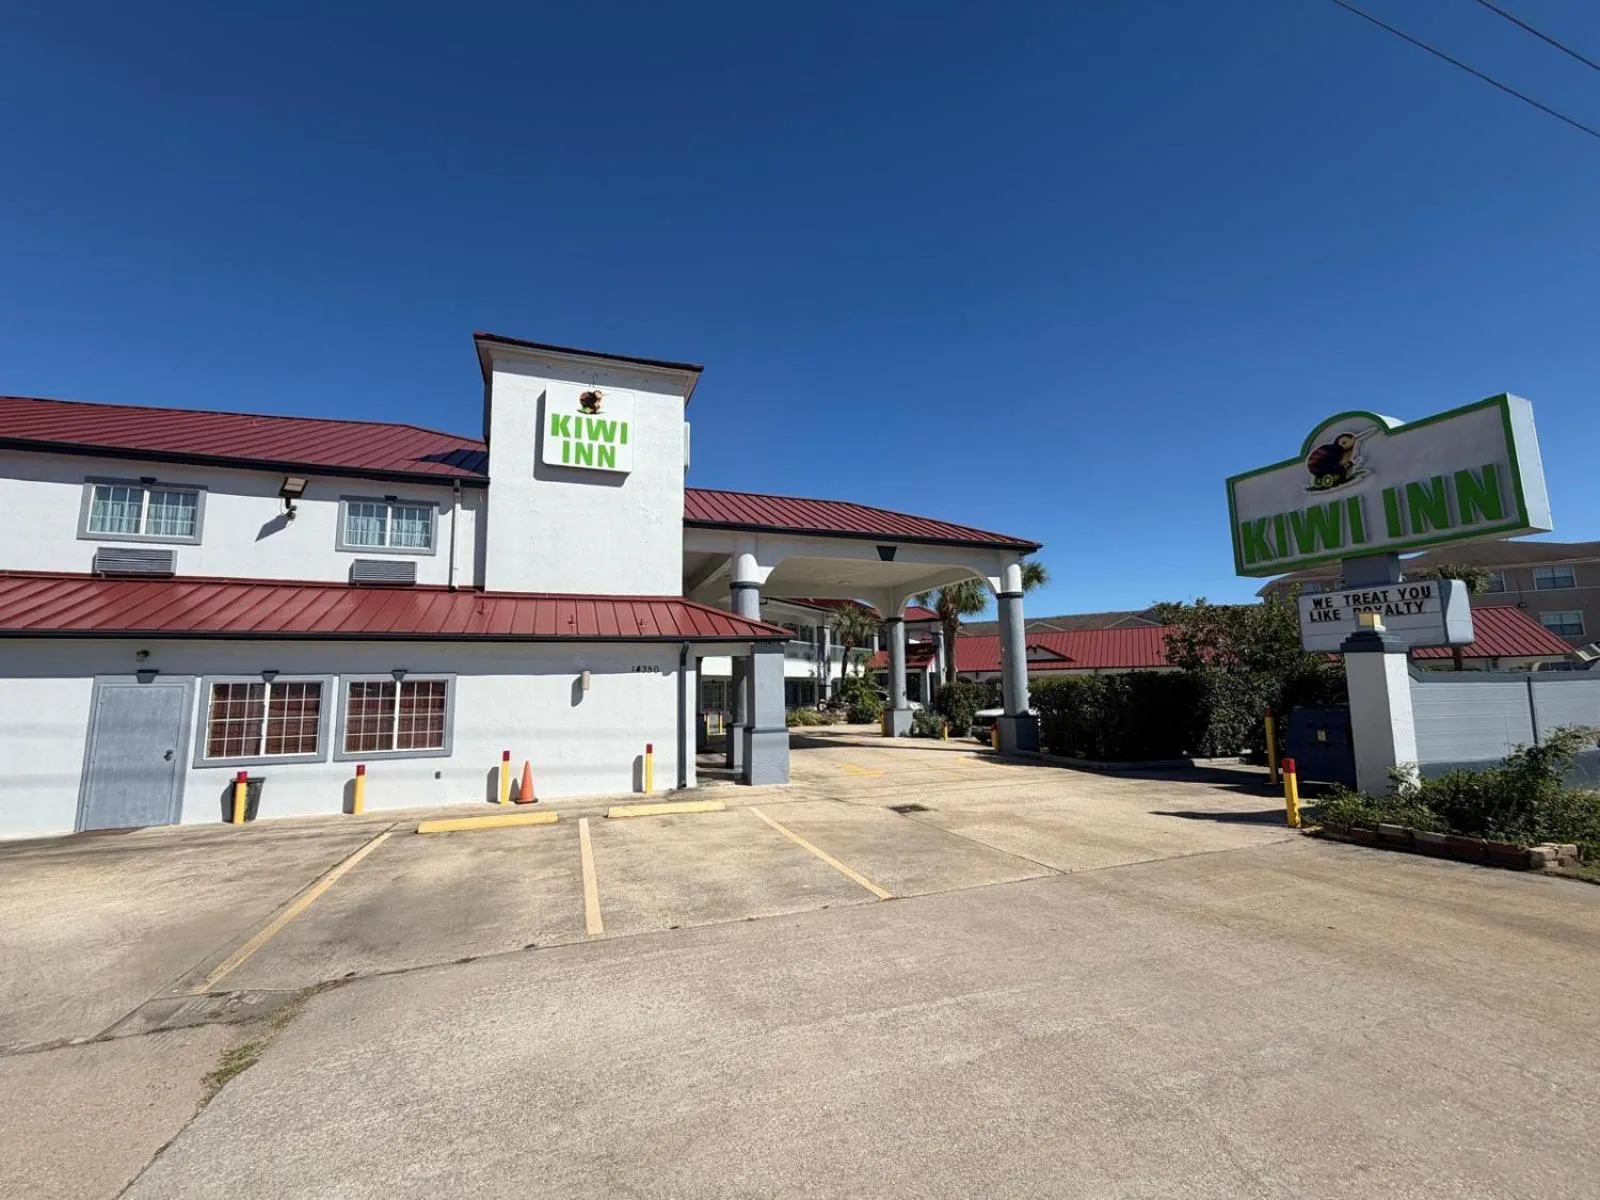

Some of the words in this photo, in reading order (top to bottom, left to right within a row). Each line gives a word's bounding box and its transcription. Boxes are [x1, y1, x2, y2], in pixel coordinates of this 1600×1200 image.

[551, 413, 628, 444] KIWI
[562, 440, 616, 468] INN
[1241, 495, 1367, 565] KIWI
[1382, 463, 1504, 538] INN
[1312, 597, 1333, 610] WE
[1343, 590, 1390, 607] TREAT
[1397, 585, 1432, 600] YOU
[1309, 609, 1342, 623] LIKE
